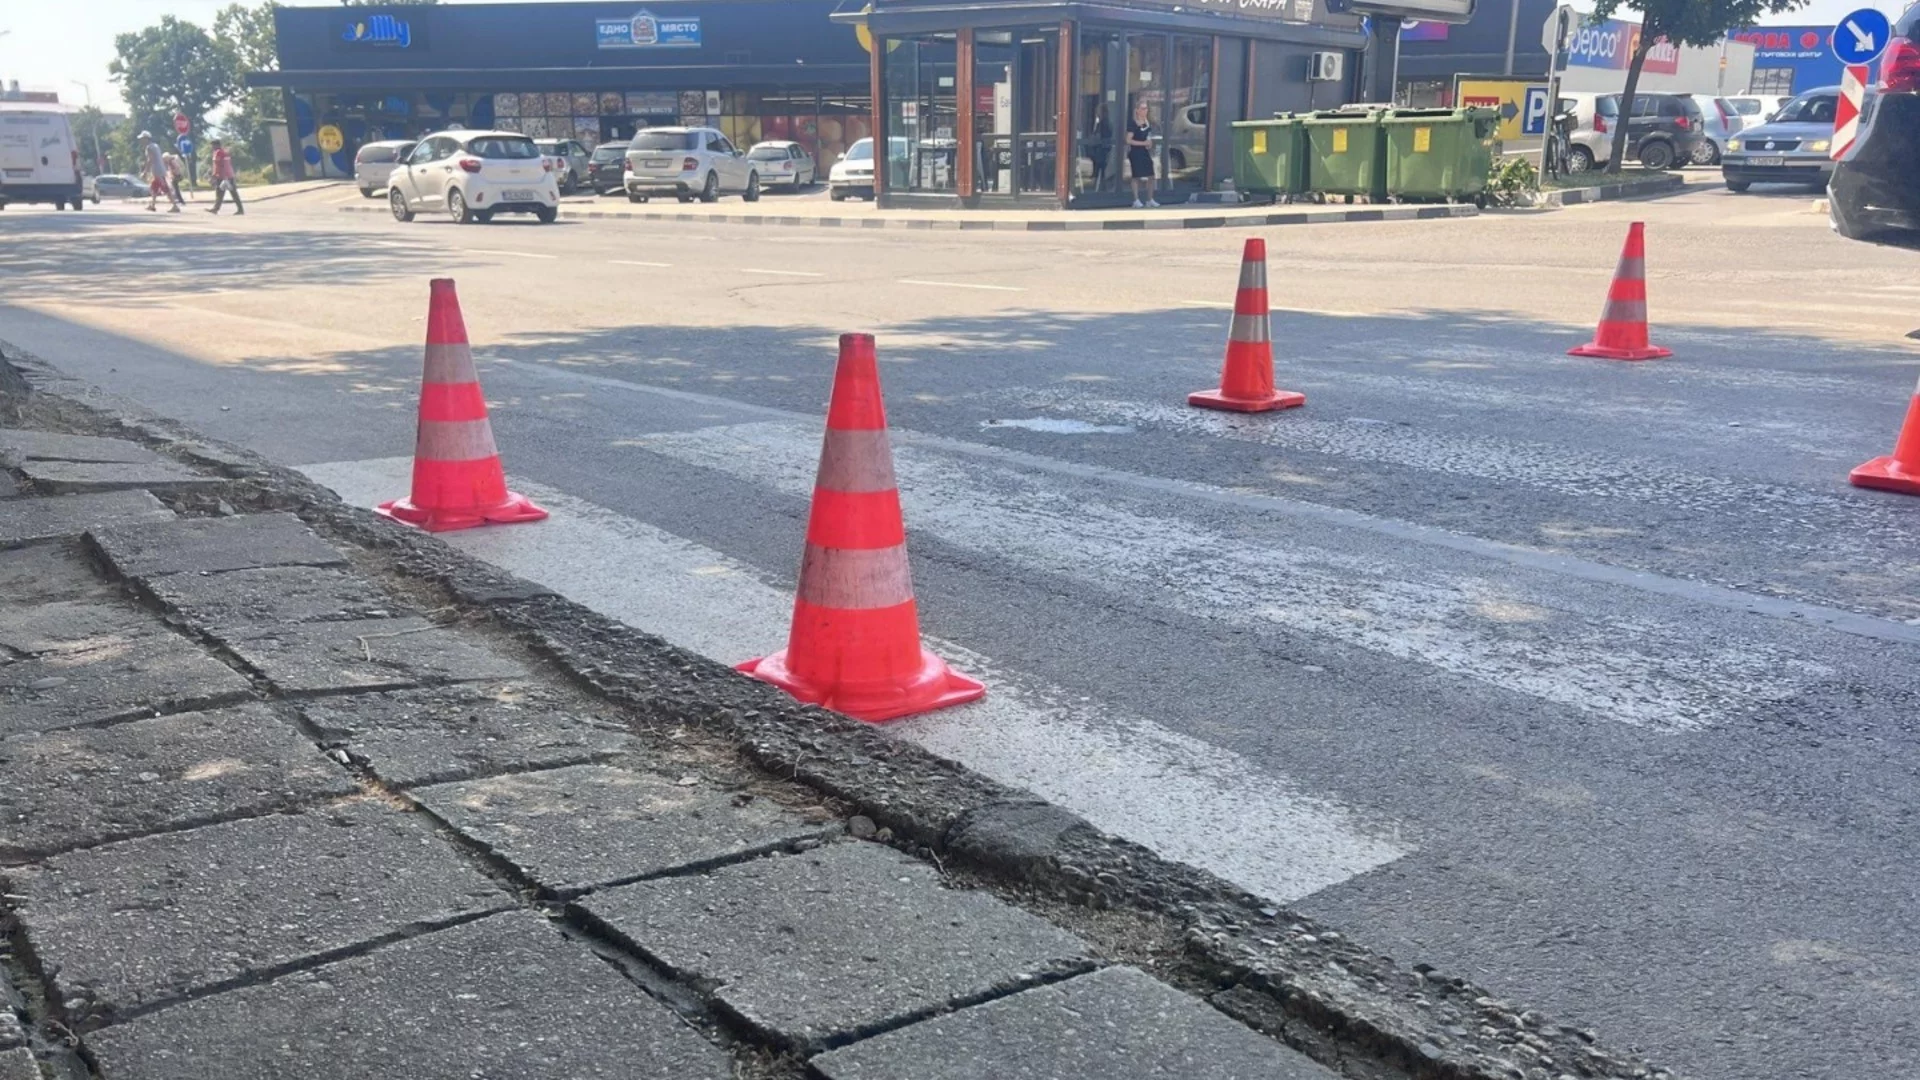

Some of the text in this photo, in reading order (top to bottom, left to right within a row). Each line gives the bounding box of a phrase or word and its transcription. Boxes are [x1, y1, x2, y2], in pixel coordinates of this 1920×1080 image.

[599, 23, 698, 34] ЕДНО МЯСТО
[1568, 28, 1617, 62] pepco
[1527, 90, 1549, 131] P
